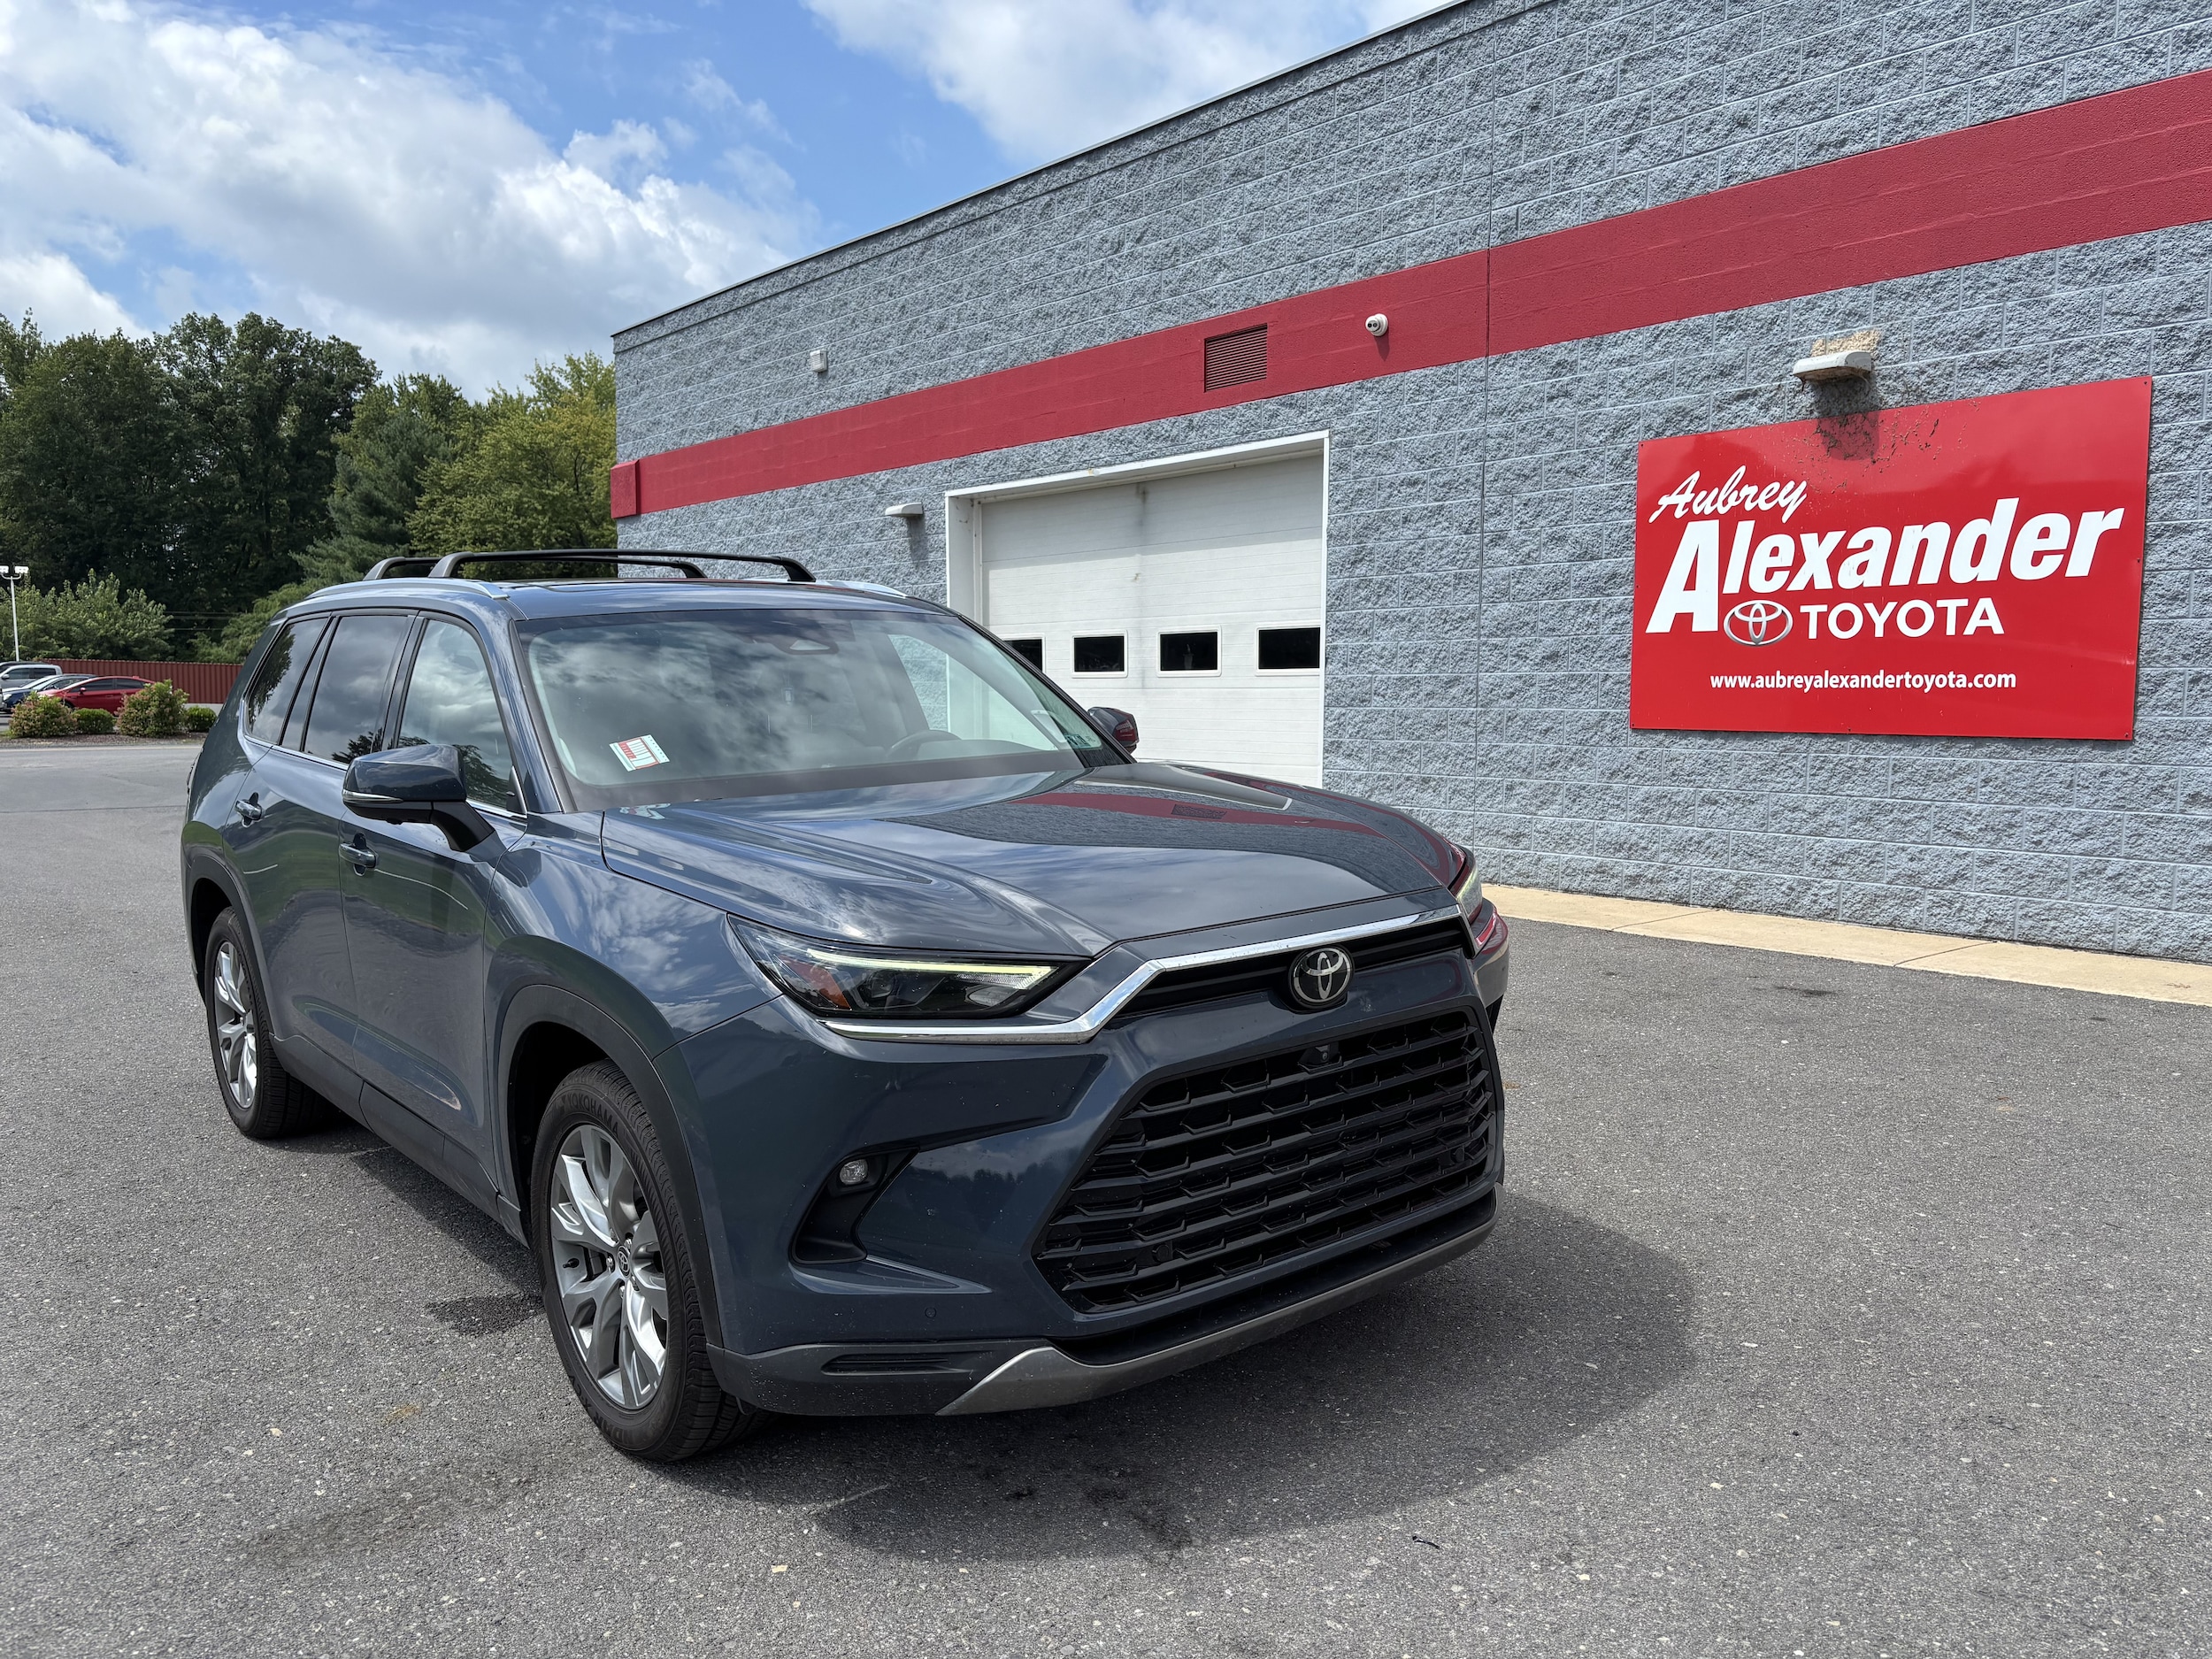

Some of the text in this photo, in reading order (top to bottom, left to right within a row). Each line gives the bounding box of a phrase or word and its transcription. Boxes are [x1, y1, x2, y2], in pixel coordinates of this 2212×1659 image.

[1648, 465, 1808, 524] Aubrey
[1645, 497, 2125, 634] Alexander
[1799, 597, 2005, 640] TOYOTA
[1709, 669, 2016, 694] www.aubreyalexandertoyota.com
[567, 1092, 619, 1138] YOKOHAMA
